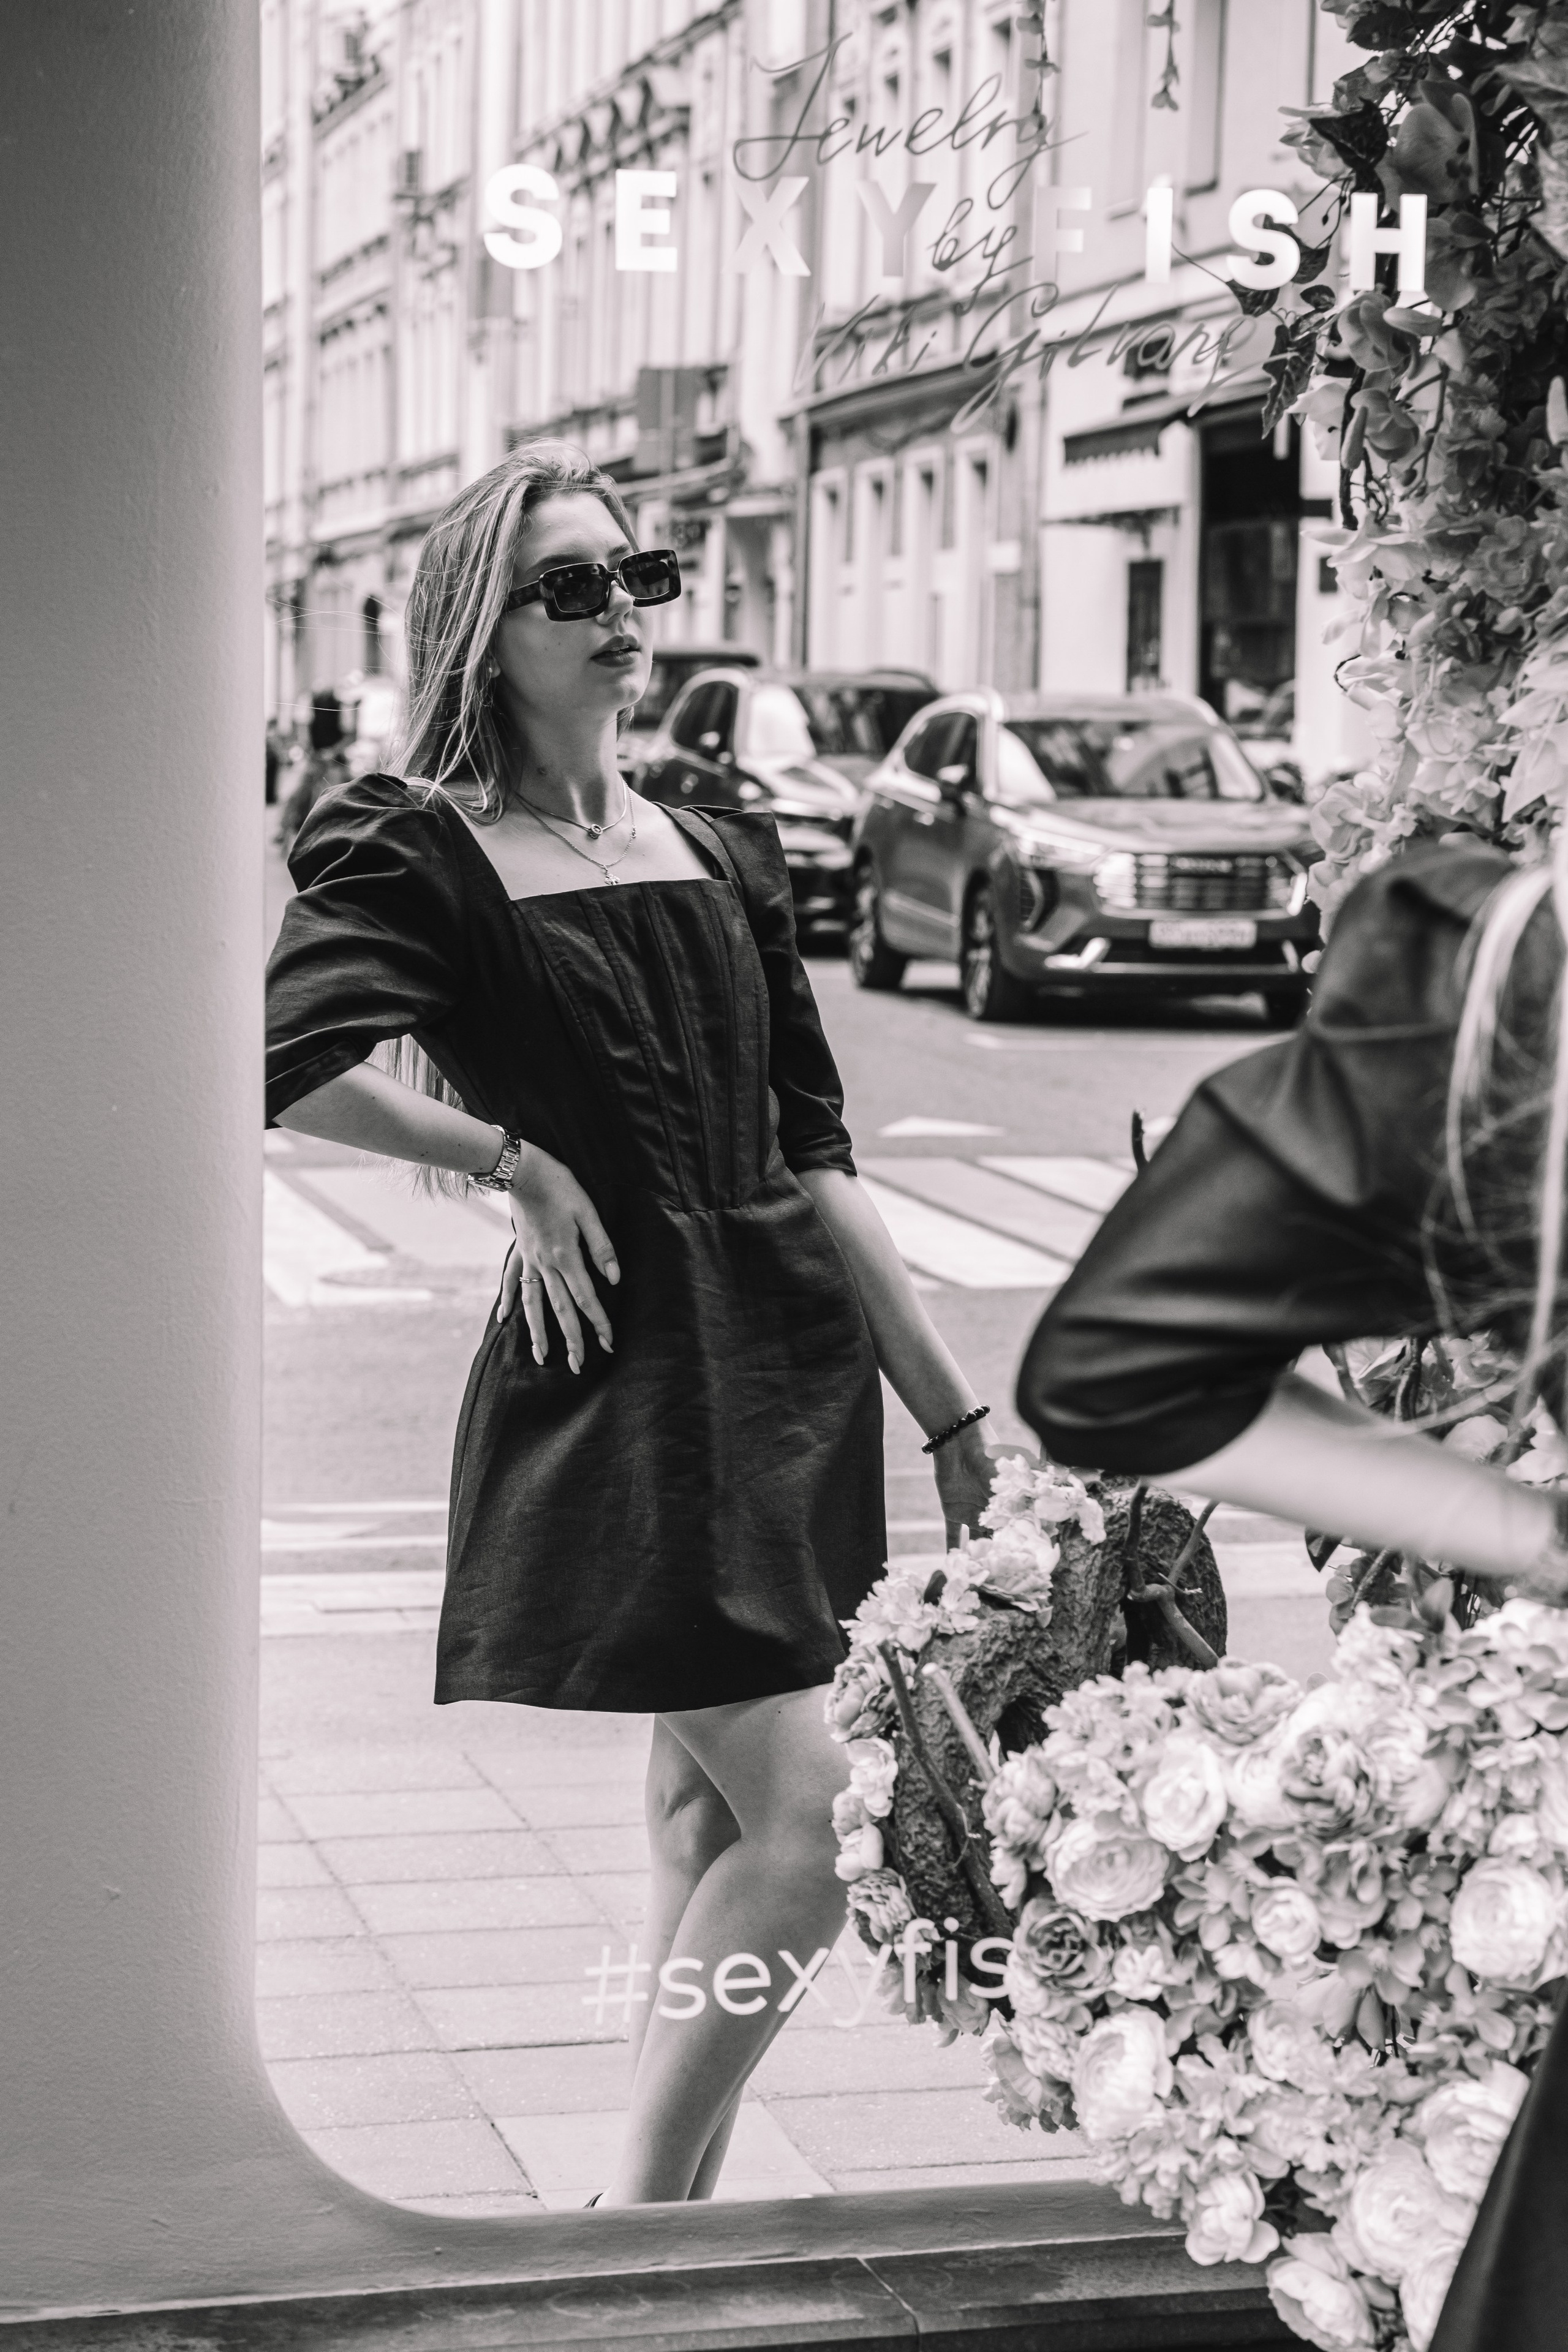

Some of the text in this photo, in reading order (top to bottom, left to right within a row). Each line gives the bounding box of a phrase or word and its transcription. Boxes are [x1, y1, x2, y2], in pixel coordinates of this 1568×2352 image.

[734, 32, 1089, 209] Jewelry
[927, 198, 1034, 316] by
[581, 1917, 1014, 2028] #sexyfis
